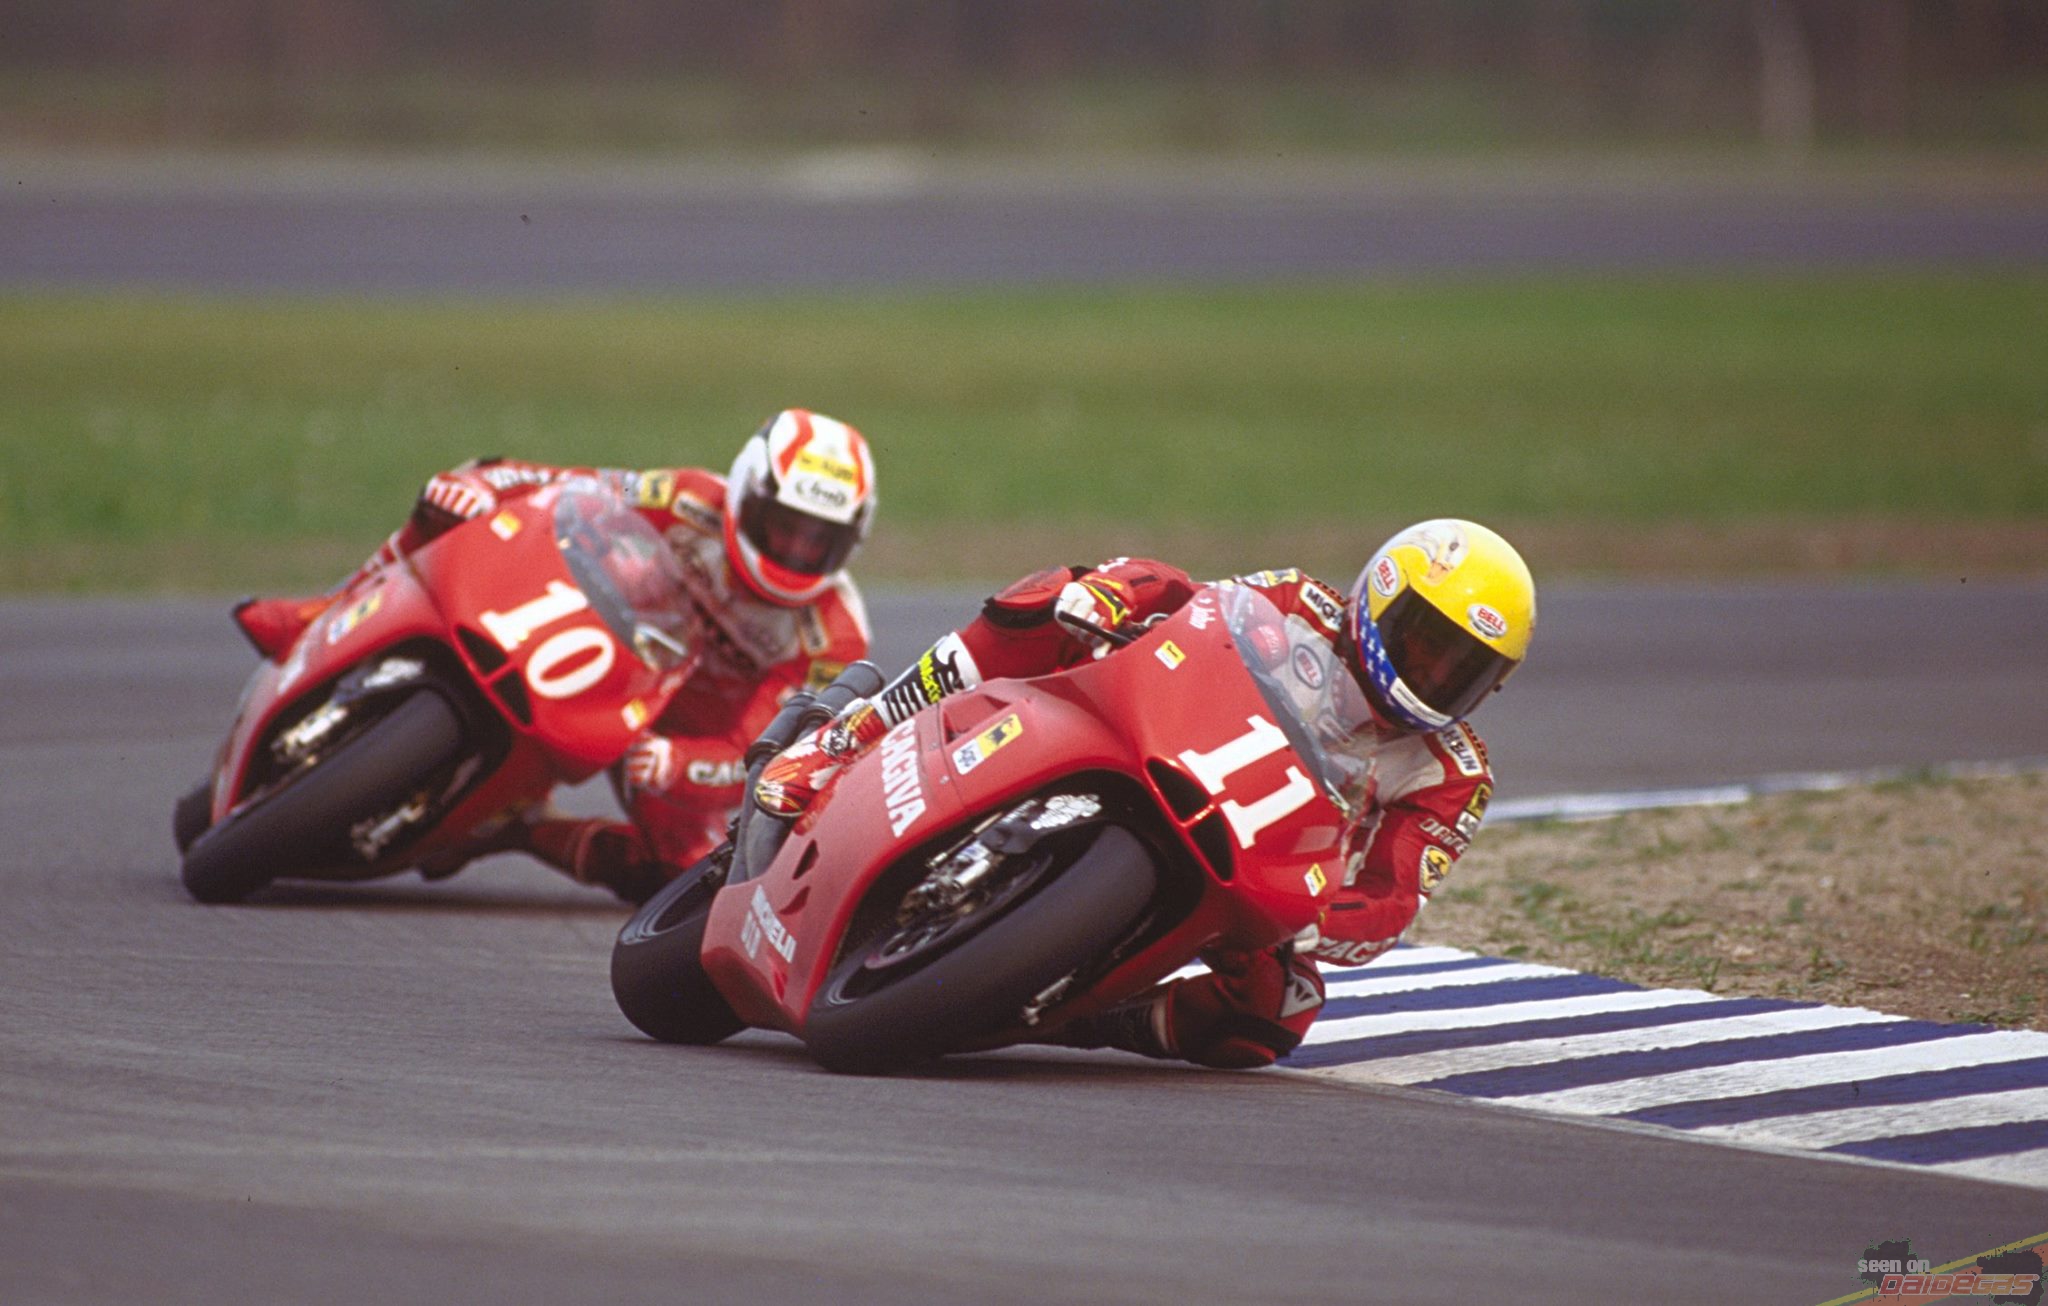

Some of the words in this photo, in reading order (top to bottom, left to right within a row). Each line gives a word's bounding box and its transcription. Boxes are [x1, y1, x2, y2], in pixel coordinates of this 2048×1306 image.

[1377, 560, 1396, 591] BELL
[1476, 607, 1506, 632] BELL
[478, 579, 616, 699] 10
[881, 718, 926, 838] CAGIVA
[1177, 714, 1317, 850] 11
